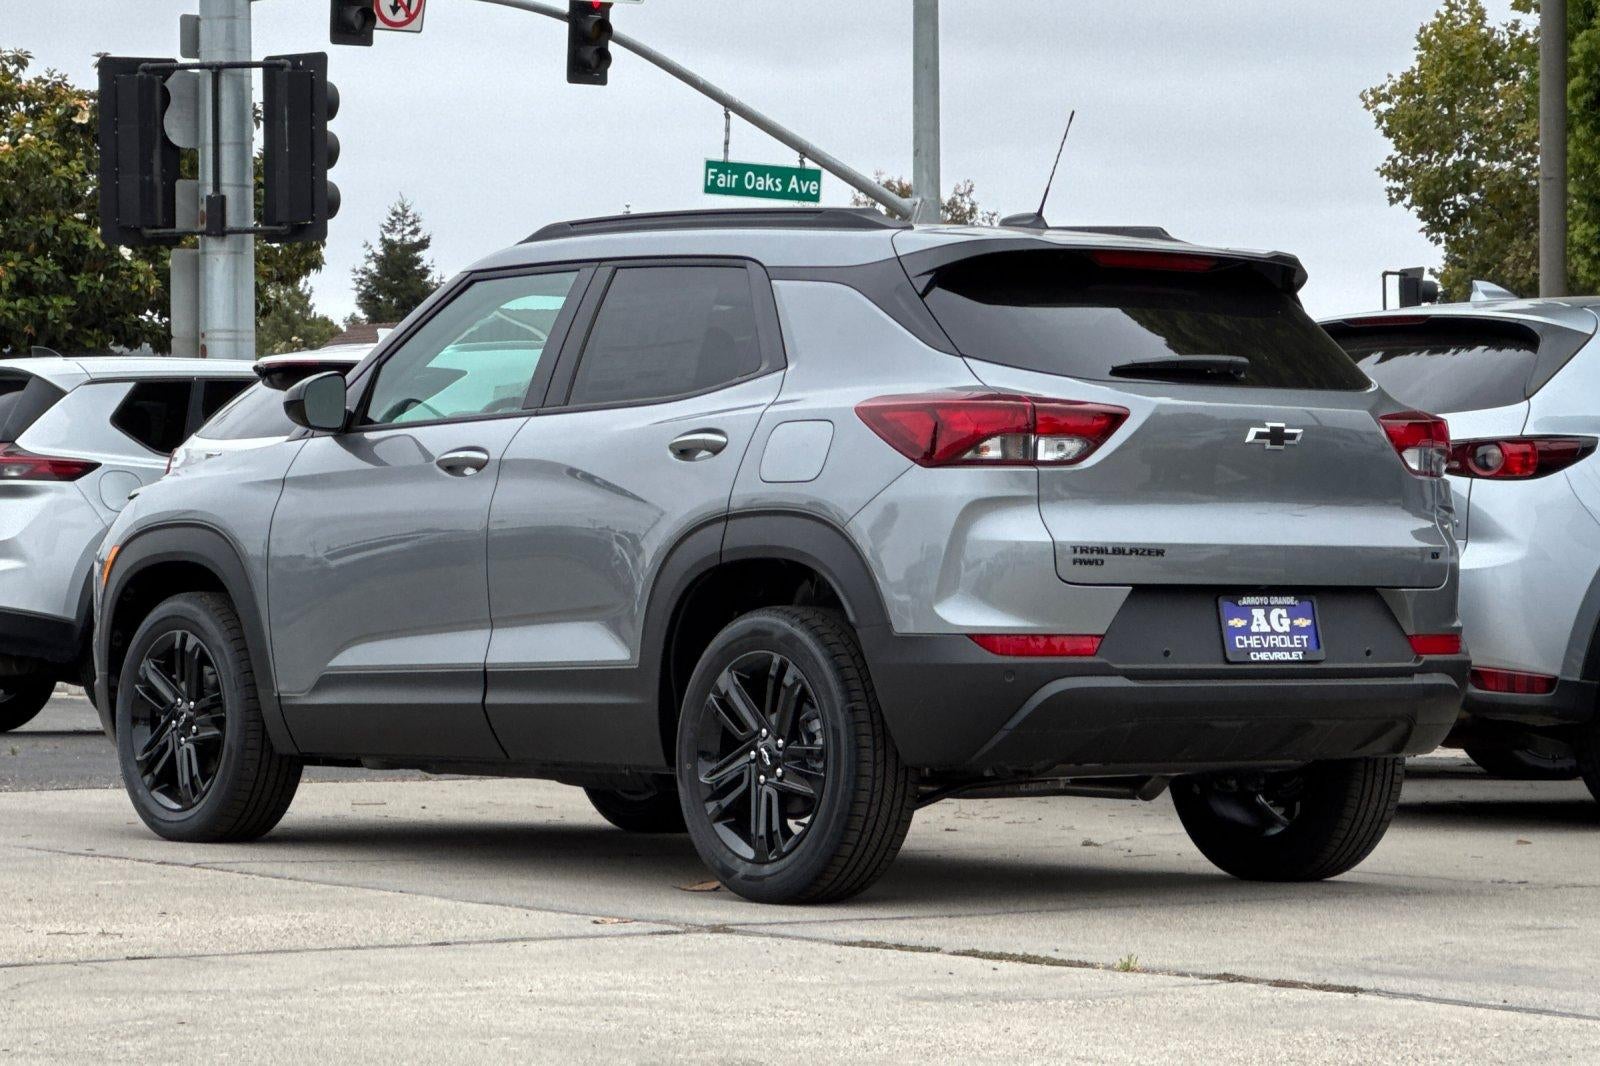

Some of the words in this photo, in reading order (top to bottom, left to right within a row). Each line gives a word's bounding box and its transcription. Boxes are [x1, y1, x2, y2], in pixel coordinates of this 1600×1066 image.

[707, 168, 738, 188] Fair
[744, 172, 782, 192] Oaks
[787, 175, 819, 195] Ave
[1071, 545, 1166, 557] TRAILBLAZER
[1072, 558, 1104, 566] AWD
[1242, 597, 1268, 606] ARROYO
[1269, 596, 1295, 605] GRANDE
[1250, 608, 1291, 633] AG
[1235, 635, 1308, 648] CHEVROLET
[1250, 651, 1304, 660] CHEVROLET
